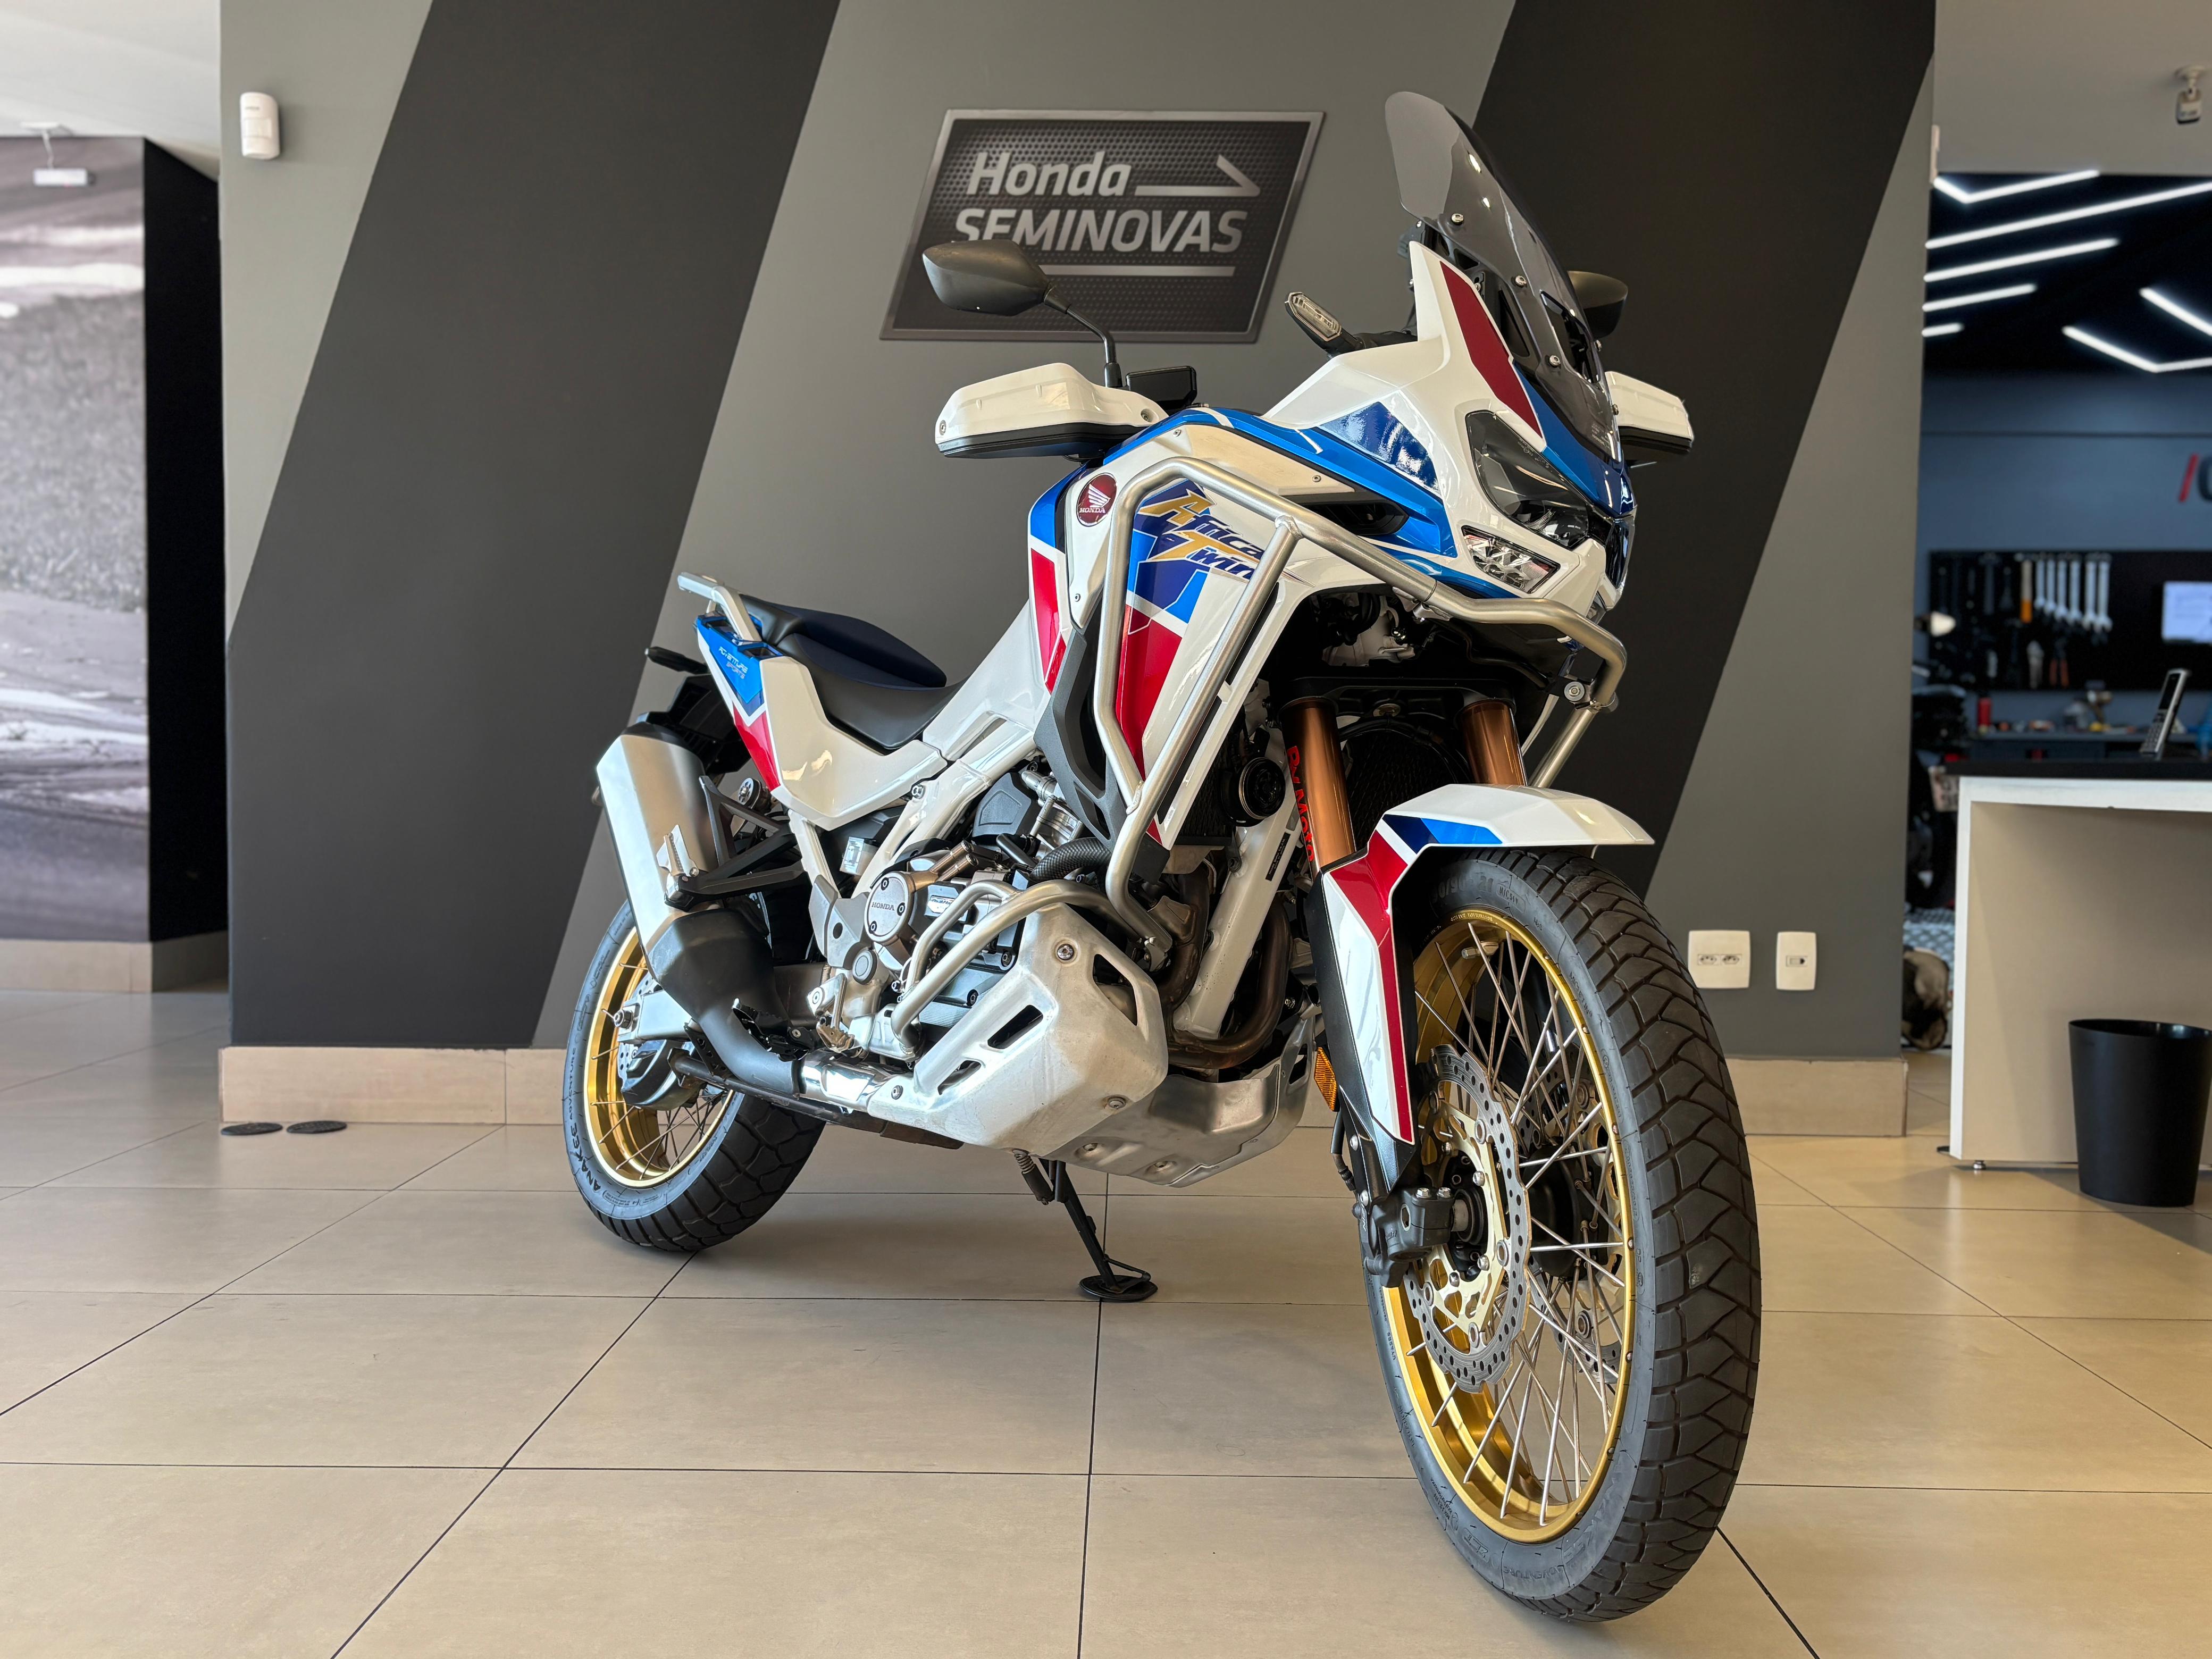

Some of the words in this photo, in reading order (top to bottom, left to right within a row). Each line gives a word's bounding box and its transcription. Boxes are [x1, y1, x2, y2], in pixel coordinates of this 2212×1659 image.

[966, 150, 1132, 197] Honda
[951, 208, 1249, 253] SEMINOVAS
[1137, 488, 1267, 562] Africa
[1147, 531, 1260, 582] Twin
[871, 901, 895, 911] HONDA
[568, 1047, 576, 1120] ADVENTURE
[569, 1122, 601, 1193] ANAKEE
